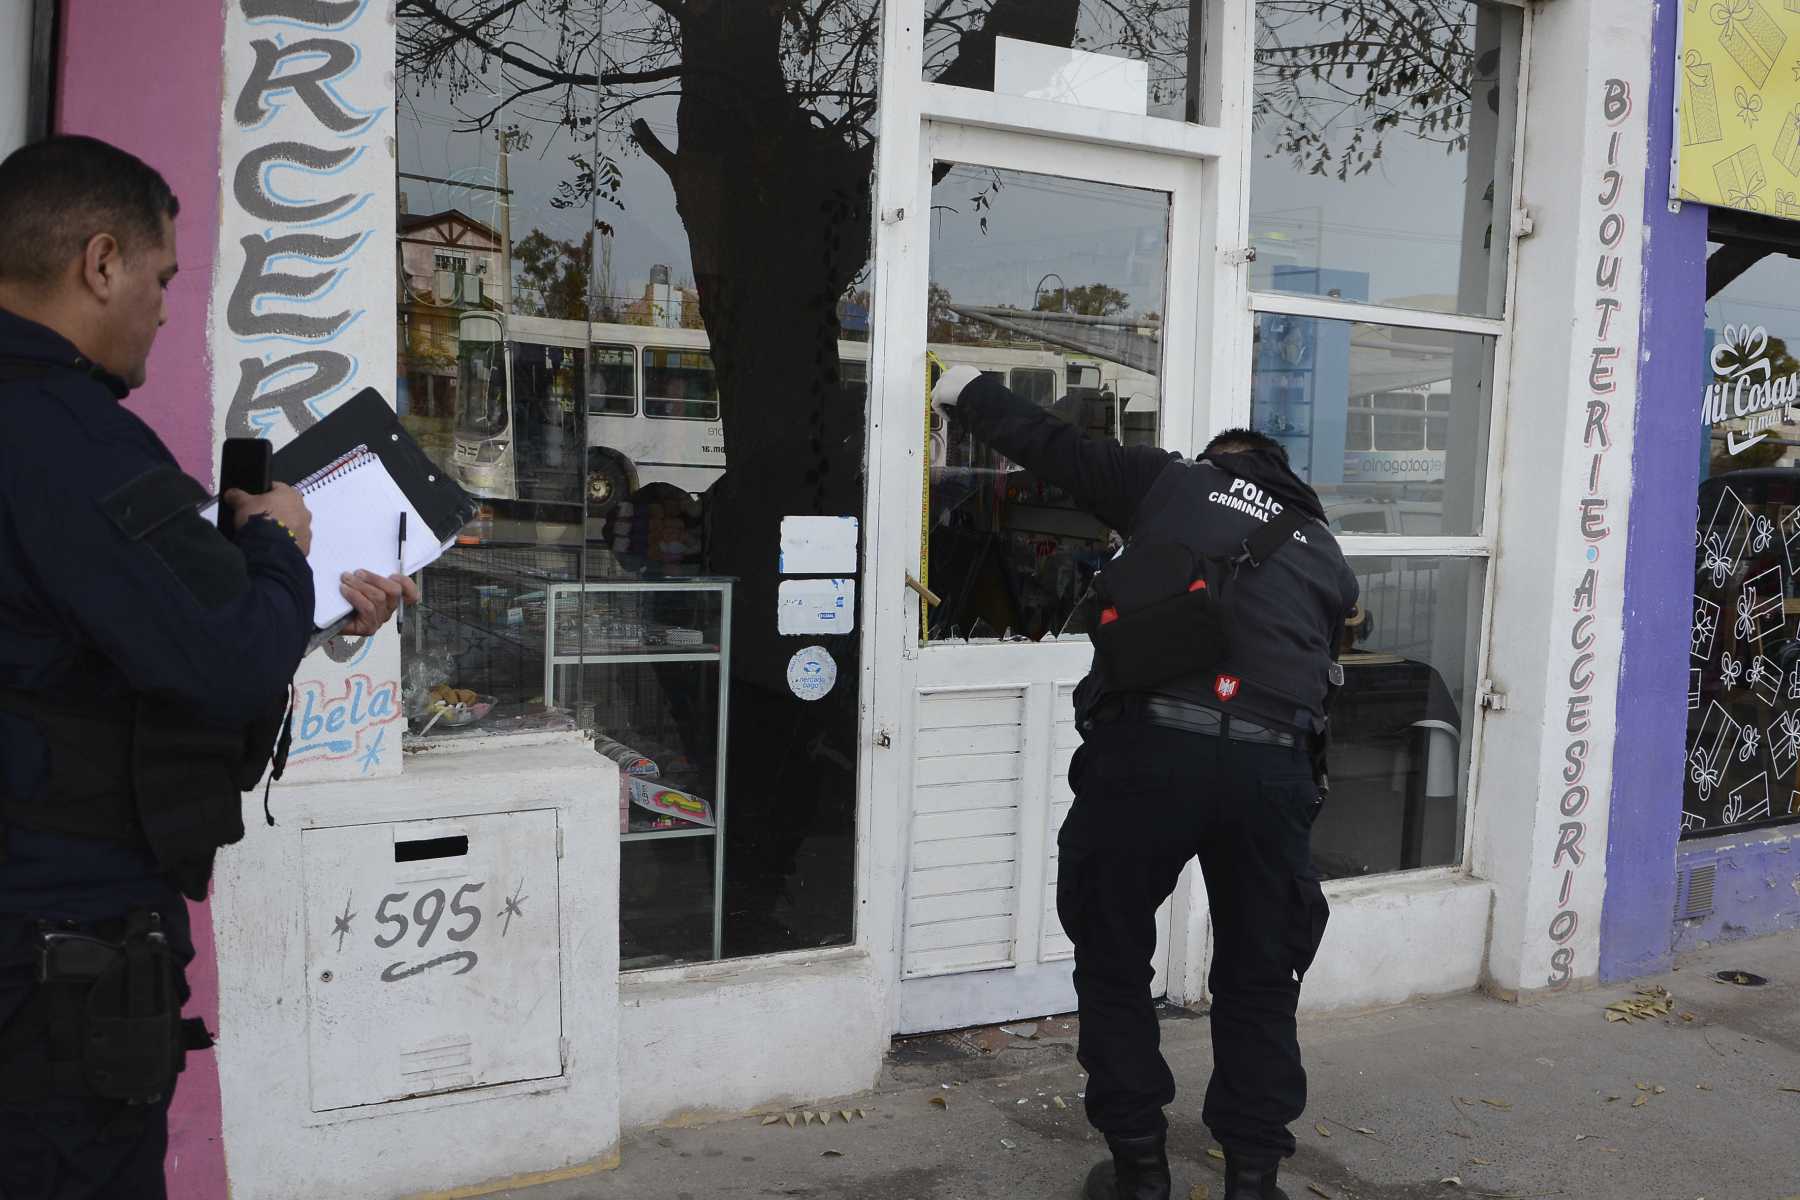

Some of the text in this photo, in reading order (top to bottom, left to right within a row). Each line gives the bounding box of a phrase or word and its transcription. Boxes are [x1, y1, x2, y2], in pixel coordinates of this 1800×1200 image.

[1734, 372, 1797, 416] Cosas
[1229, 478, 1284, 515] POLIC
[1548, 77, 1631, 989] BIJOUTERIE ACCESORIOS
[290, 680, 394, 741] bela
[374, 882, 487, 949] 595
